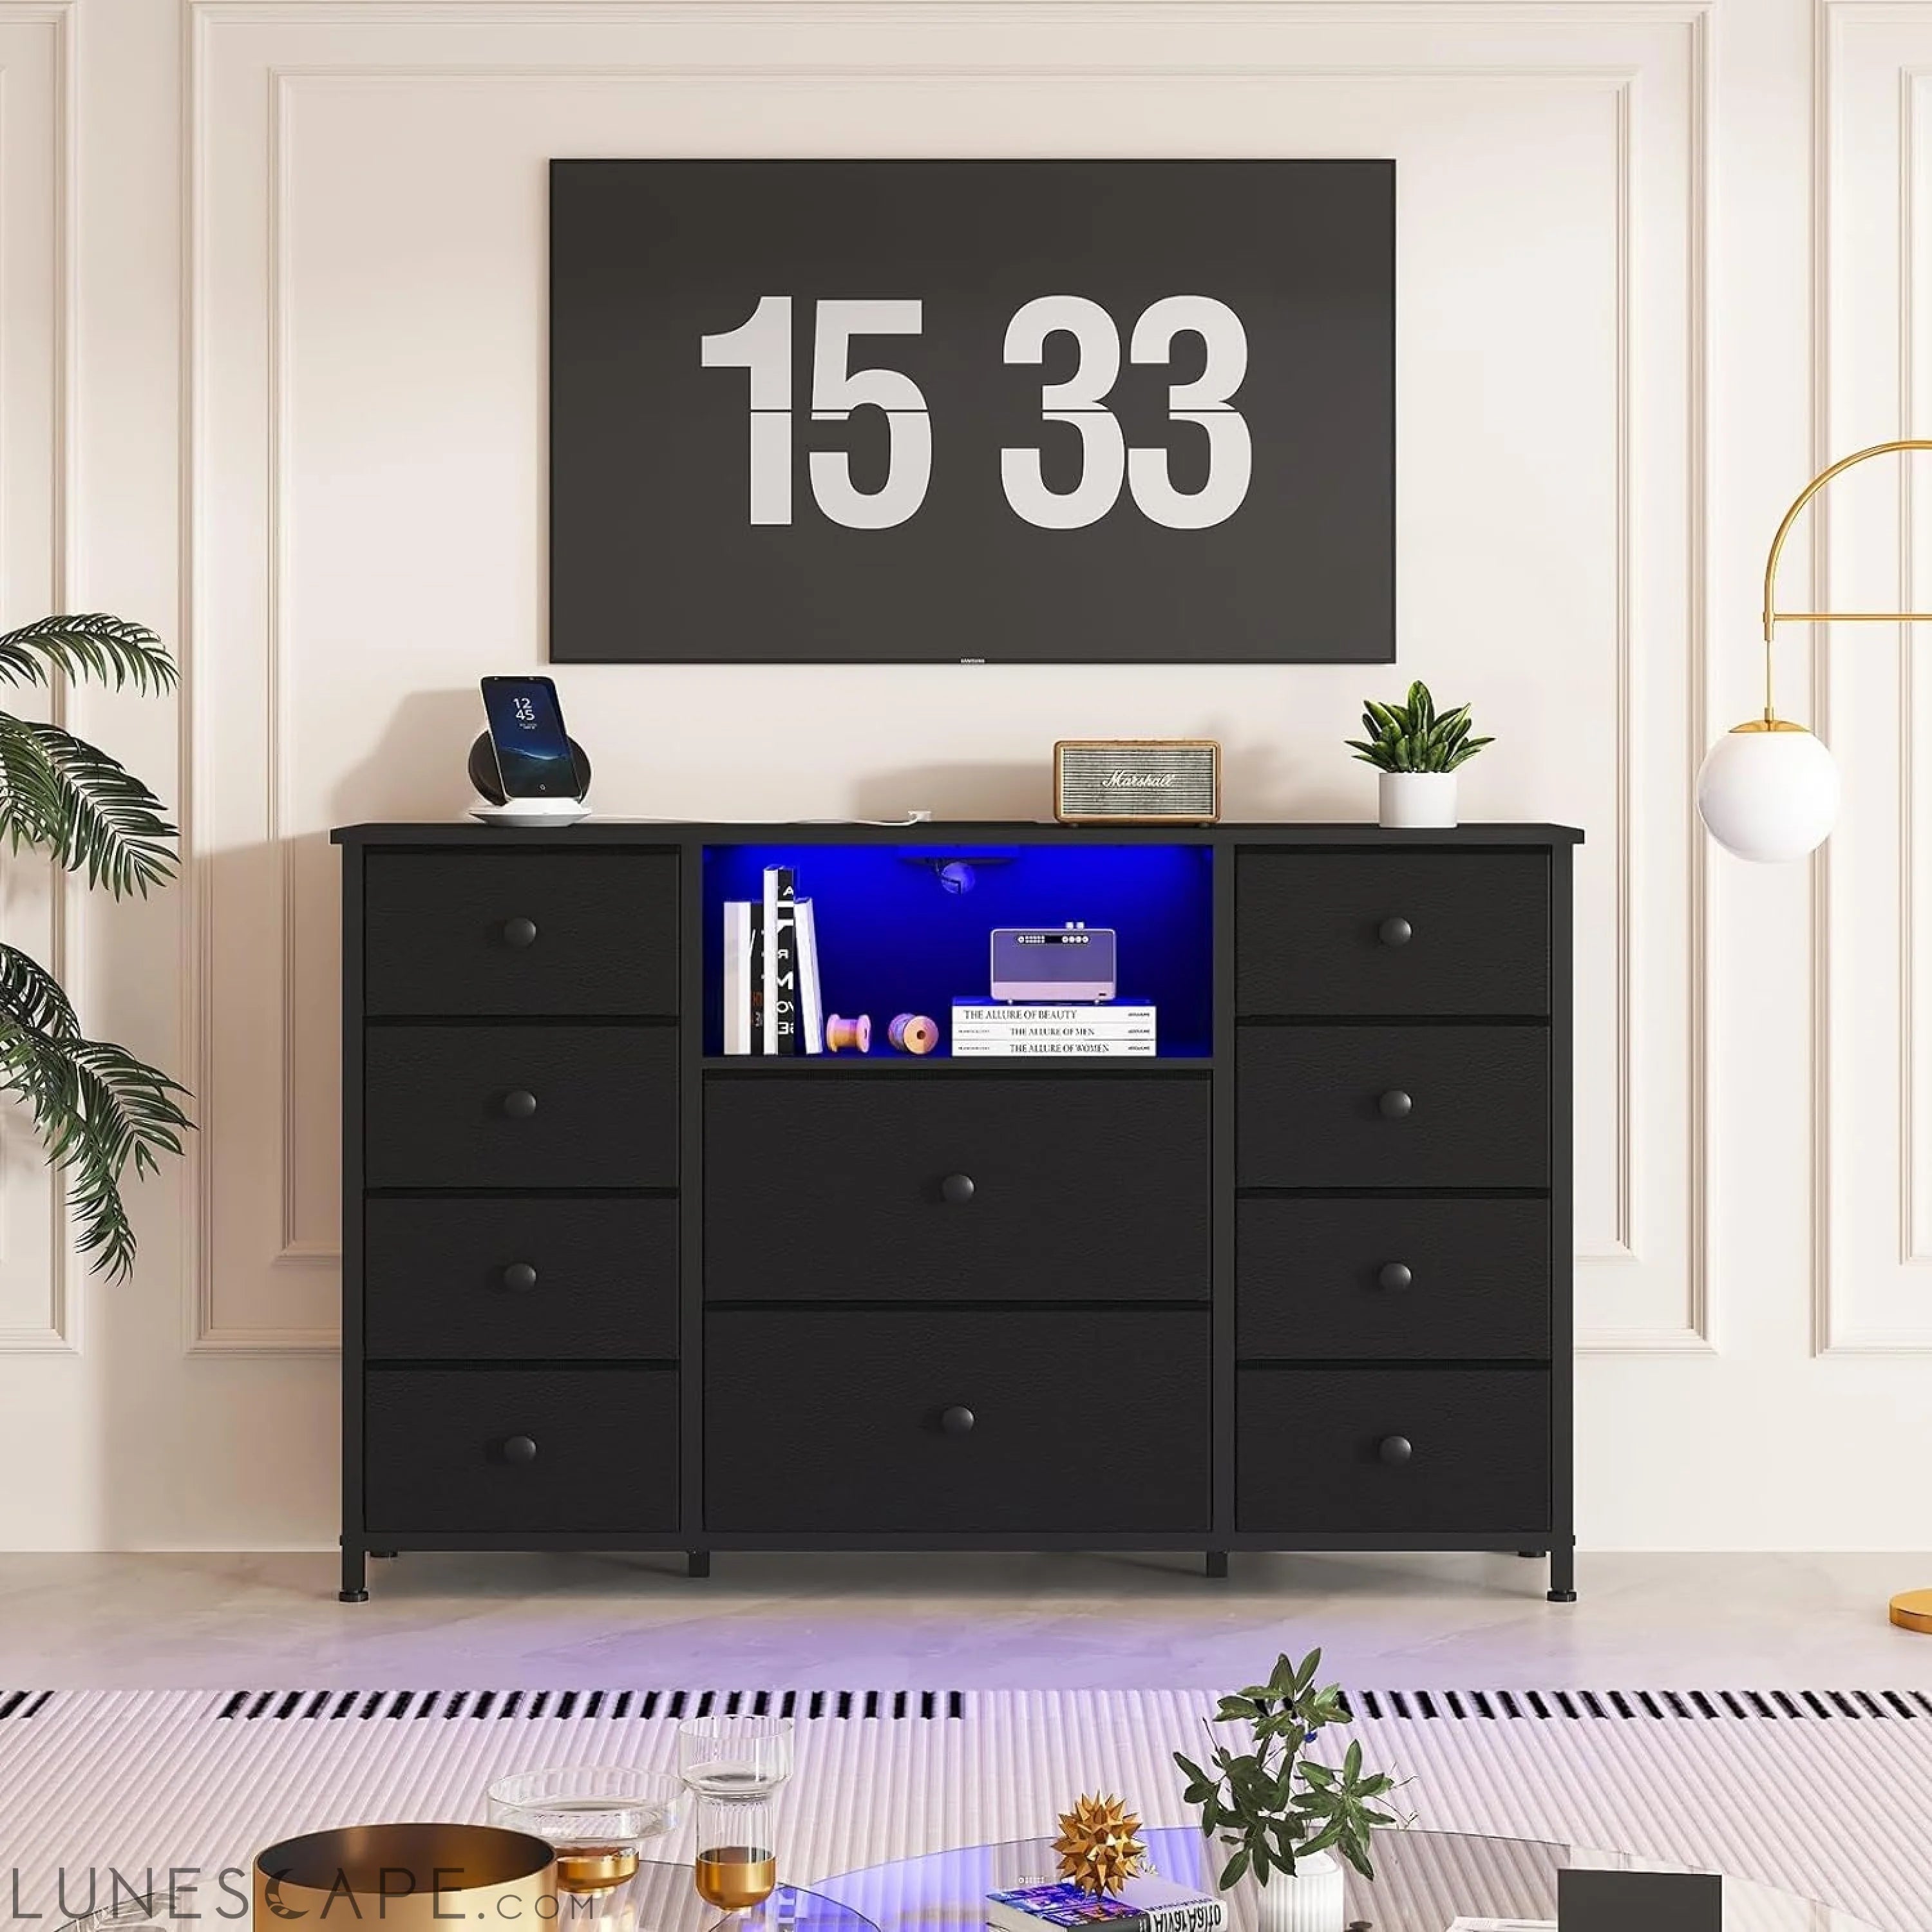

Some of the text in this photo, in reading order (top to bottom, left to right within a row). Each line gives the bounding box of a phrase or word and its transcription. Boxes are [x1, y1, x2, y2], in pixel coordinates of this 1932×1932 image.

[701, 294, 1252, 529] 15 33
[513, 697, 533, 709] 12
[516, 709, 535, 721] 45
[964, 1009, 1077, 1019] THE ALLURE OF BEAUTY
[1010, 1028, 1025, 1036] THE
[1010, 1044, 1027, 1053] THE
